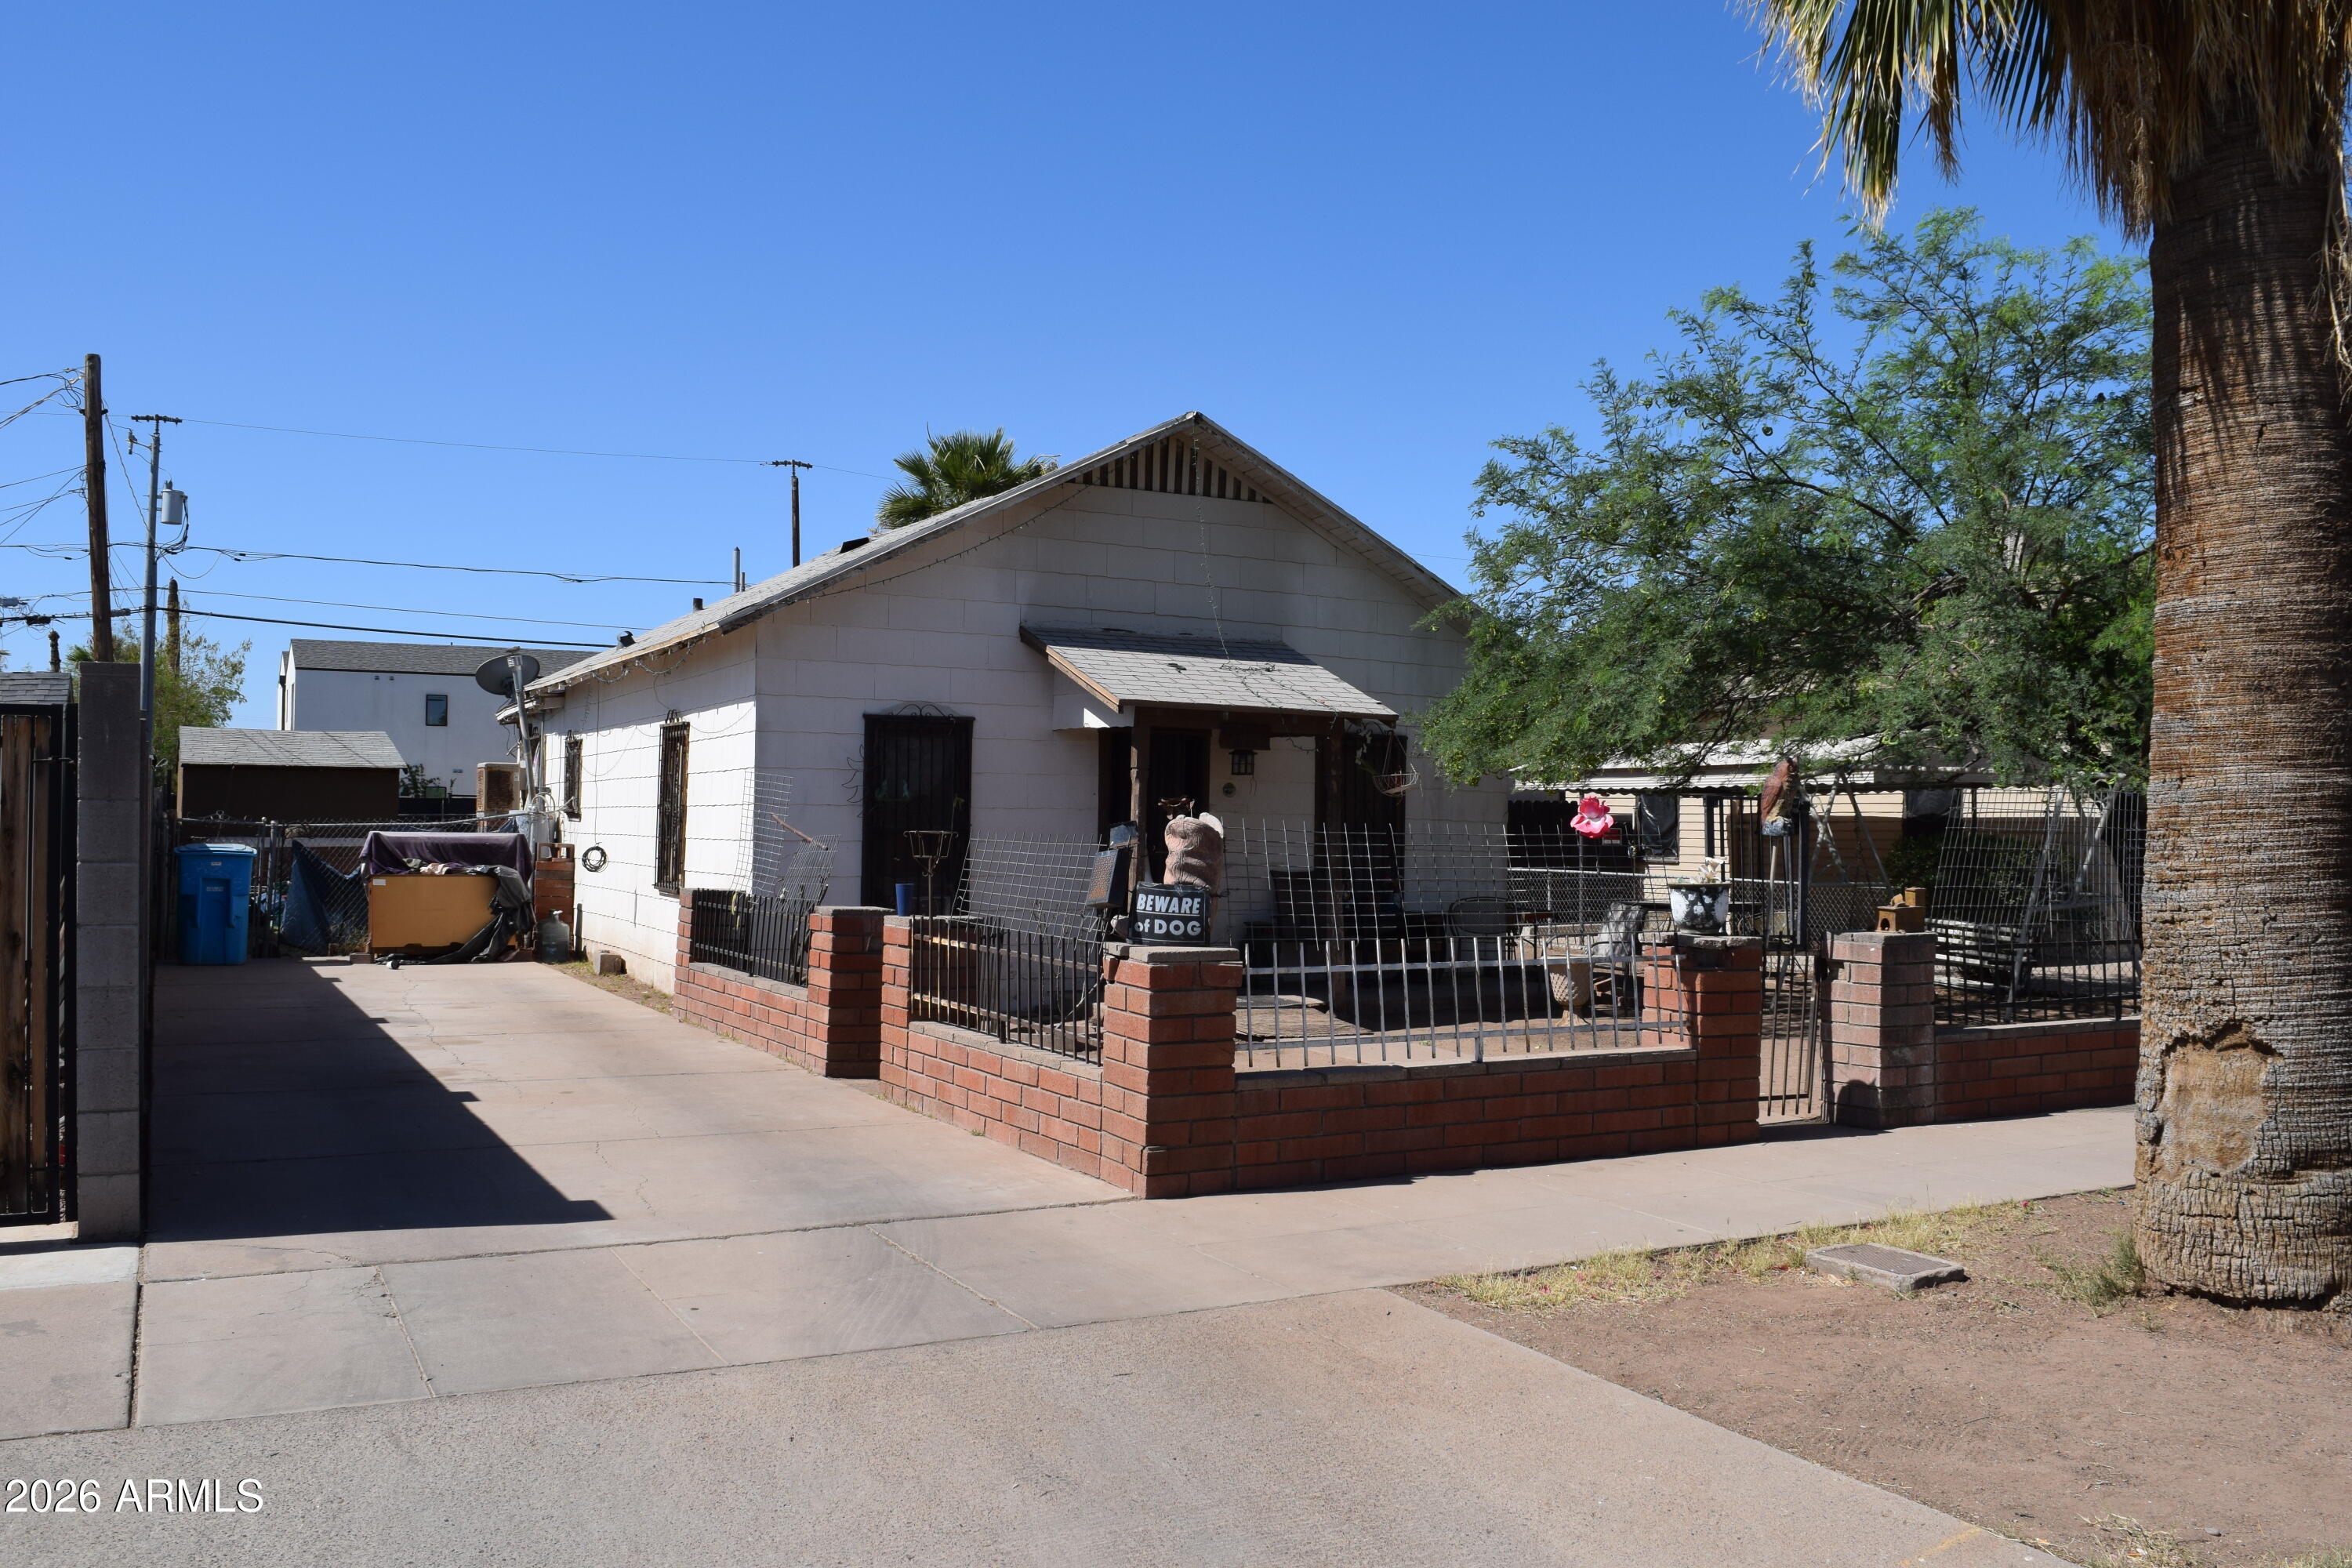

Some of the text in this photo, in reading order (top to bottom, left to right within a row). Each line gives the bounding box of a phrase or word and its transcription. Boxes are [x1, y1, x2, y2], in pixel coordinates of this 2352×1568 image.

[1136, 893, 1201, 914] BEWARE
[1134, 918, 1202, 936] of DOG
